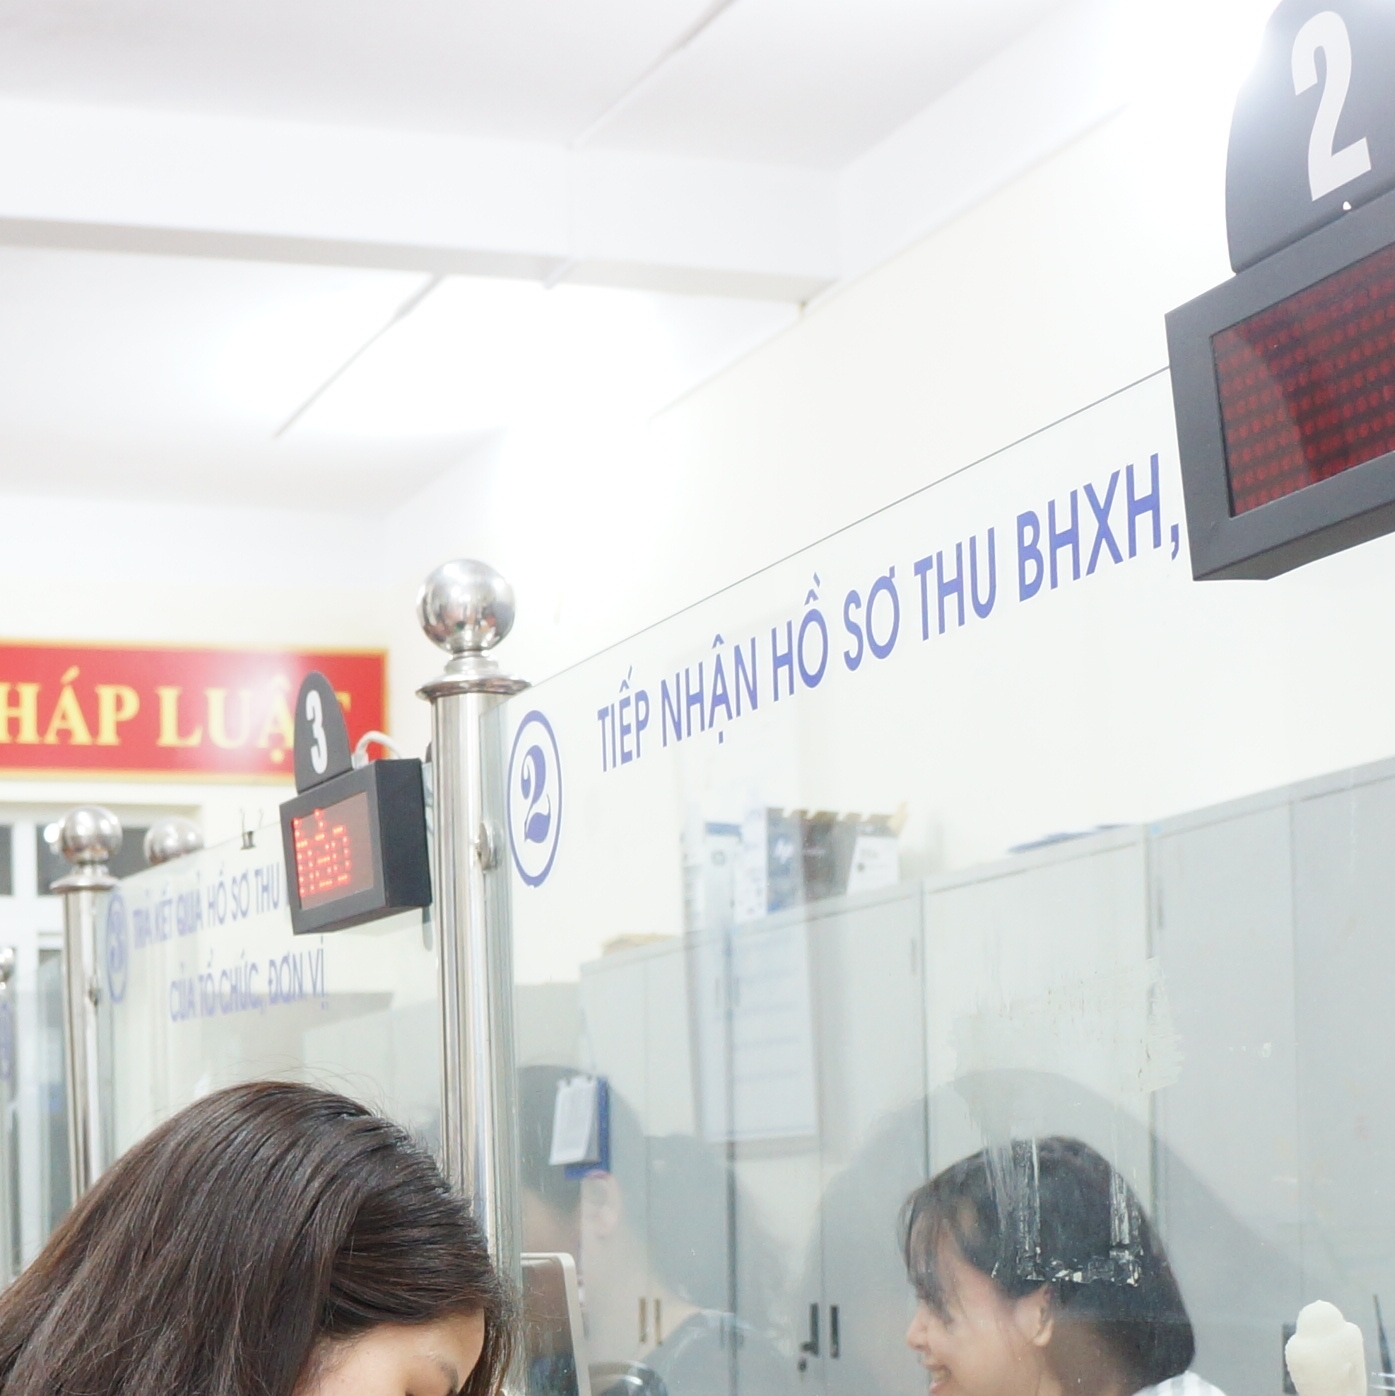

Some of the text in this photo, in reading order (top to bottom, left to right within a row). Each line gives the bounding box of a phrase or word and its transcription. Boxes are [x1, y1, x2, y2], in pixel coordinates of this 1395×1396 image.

[1291, 11, 1372, 202] 2
[597, 452, 1180, 773] TIẾP NHẬN HỒ SƠ THU BHXH,
[156, 675, 351, 764] LUẬ
[306, 690, 328, 774] 3
[520, 744, 552, 844] 2
[231, 868, 250, 922] SƠ
[254, 862, 281, 916] THU
[267, 951, 305, 1005] ĐƠN
